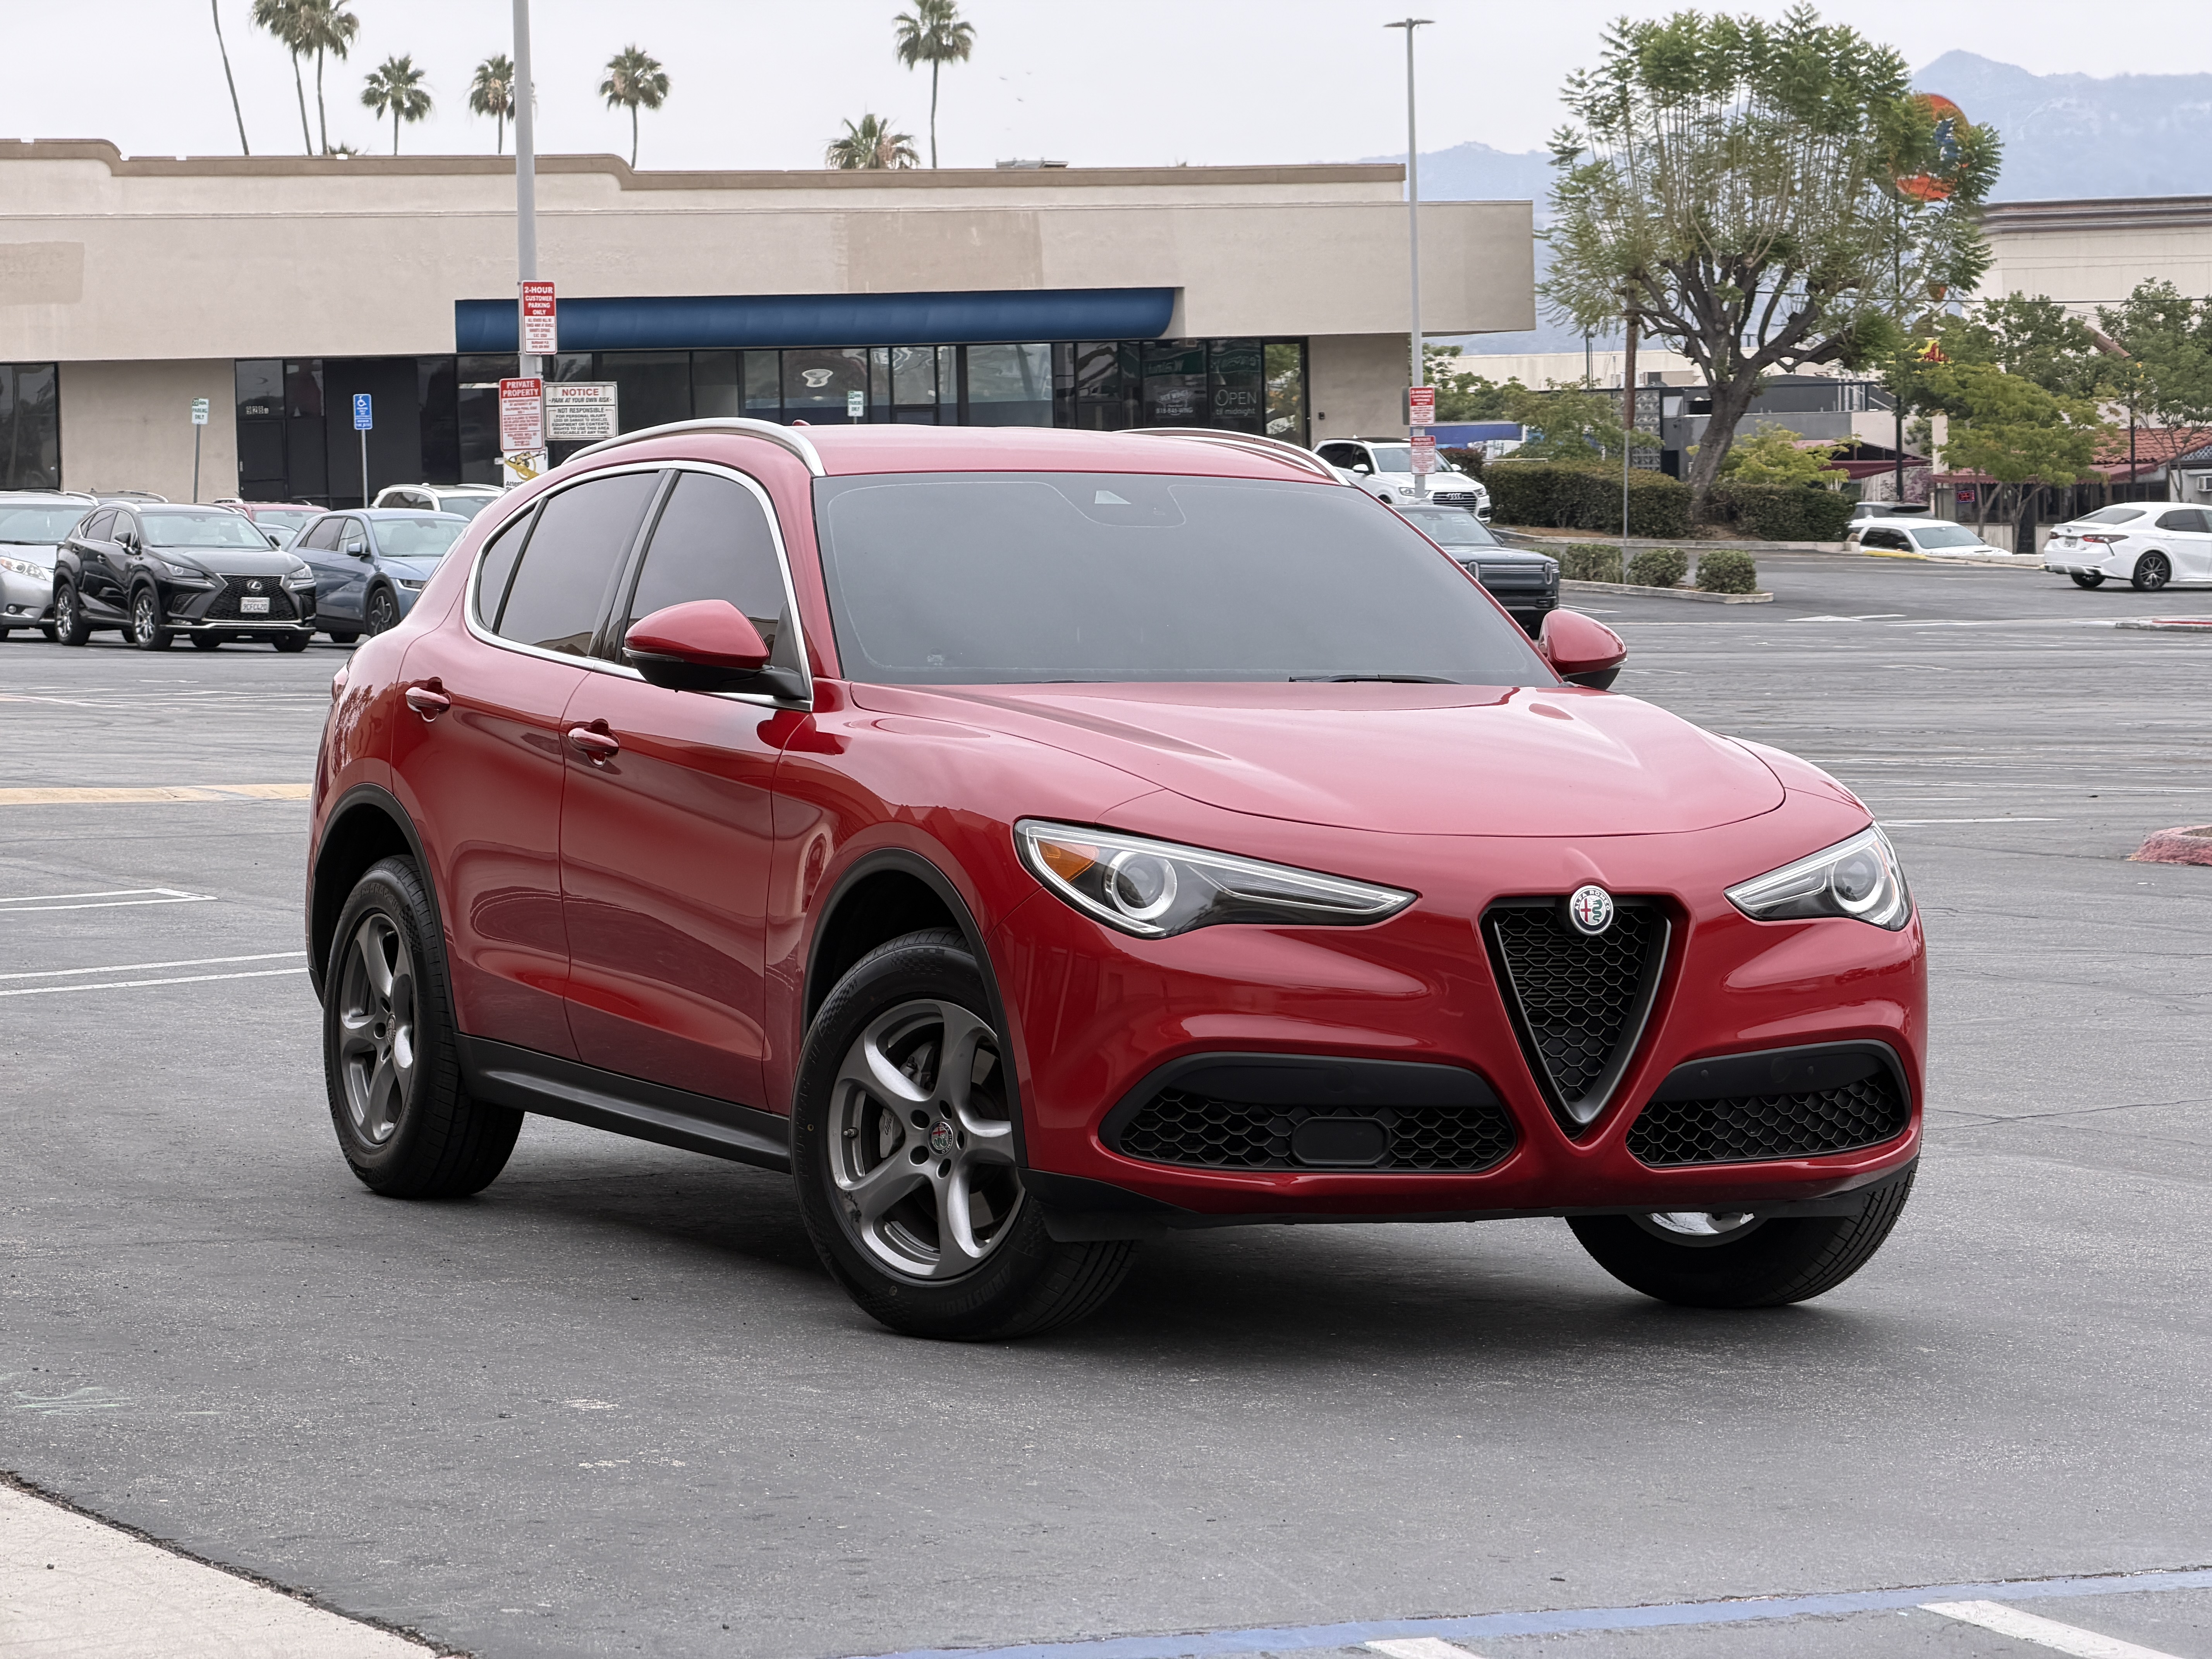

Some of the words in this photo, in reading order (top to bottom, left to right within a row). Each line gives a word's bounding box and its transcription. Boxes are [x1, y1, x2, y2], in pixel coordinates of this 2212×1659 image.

[507, 380, 535, 388] PRIVATE
[503, 388, 539, 397] PROPERTY
[1215, 389, 1257, 406] OPEN
[1575, 893, 1587, 910] ALFA
[1589, 890, 1610, 911] ROMEO
